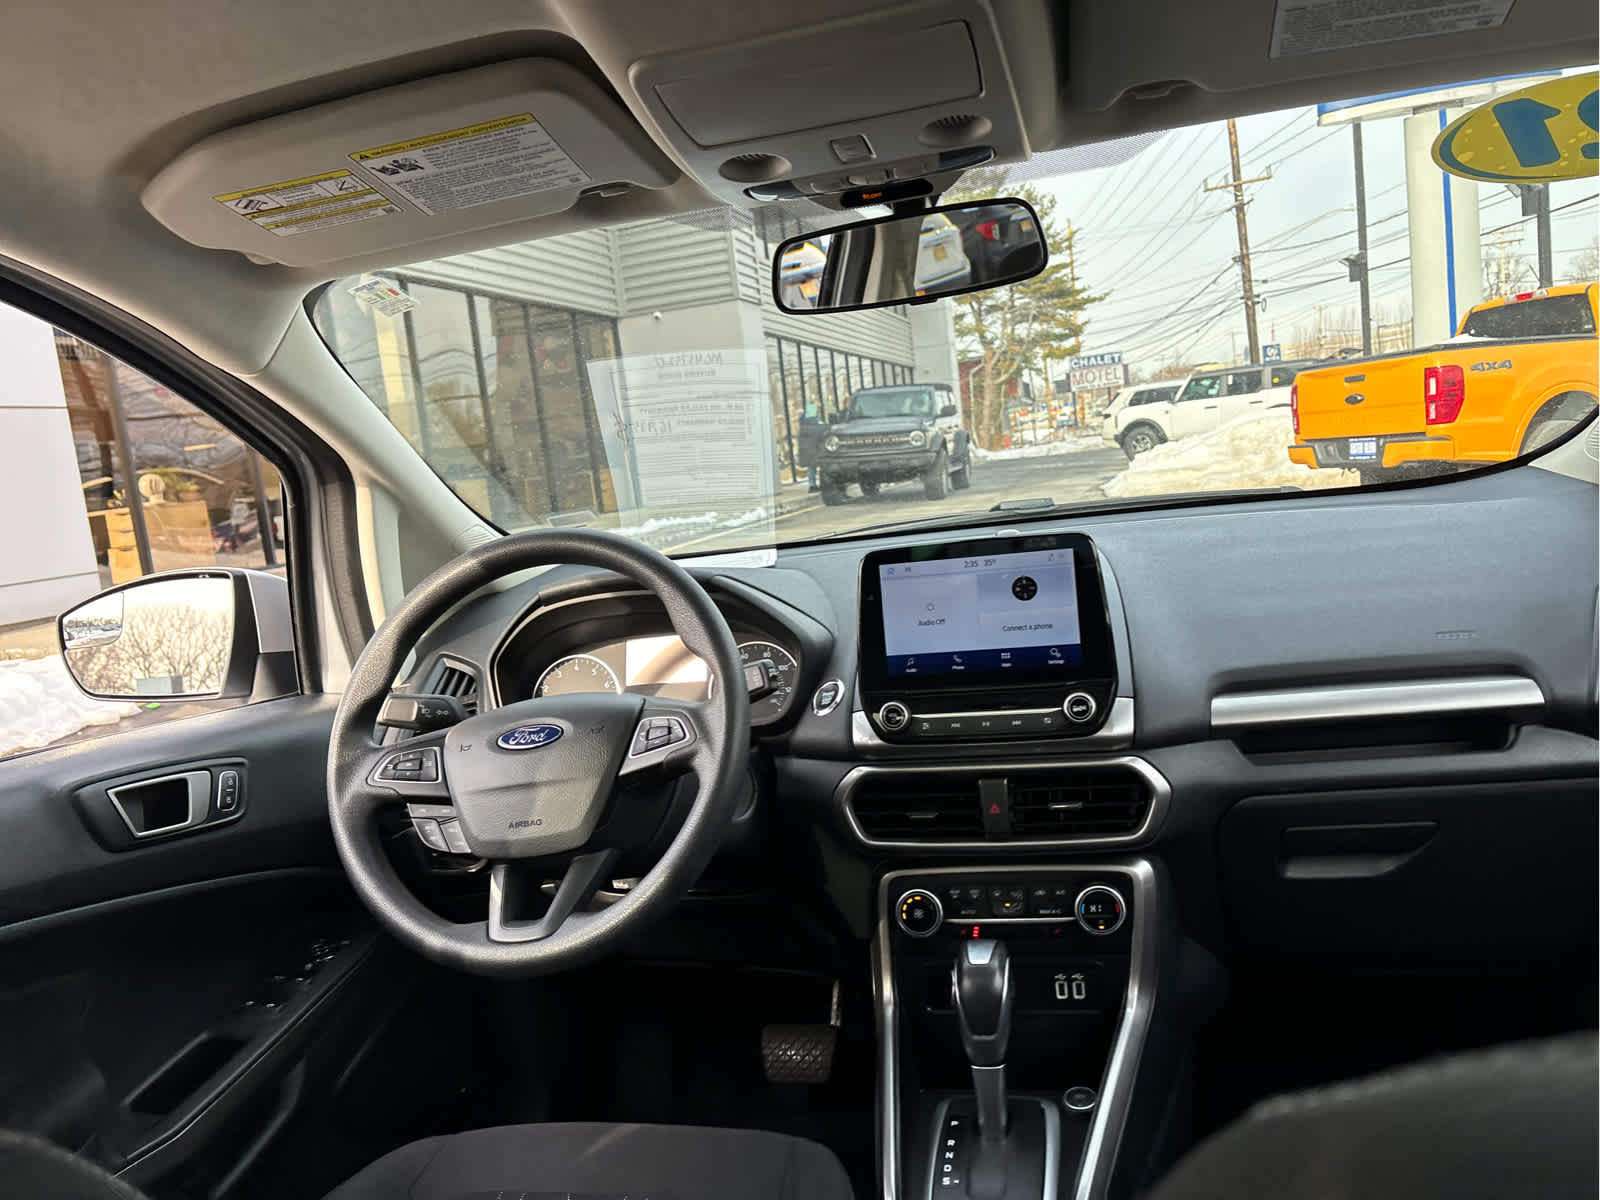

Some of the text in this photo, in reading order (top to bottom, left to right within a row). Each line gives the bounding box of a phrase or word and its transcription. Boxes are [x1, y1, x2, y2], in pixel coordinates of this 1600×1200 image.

[1071, 354, 1121, 369] CHALET
[1071, 366, 1121, 386] MOTEL
[1002, 624, 1028, 632] Connect
[1034, 623, 1053, 631] phone
[507, 727, 551, 745] Ford
[509, 819, 543, 828] AIRBAG
[947, 1139, 956, 1147] R
[944, 1164, 952, 1172] D
[942, 1177, 951, 1185] S
